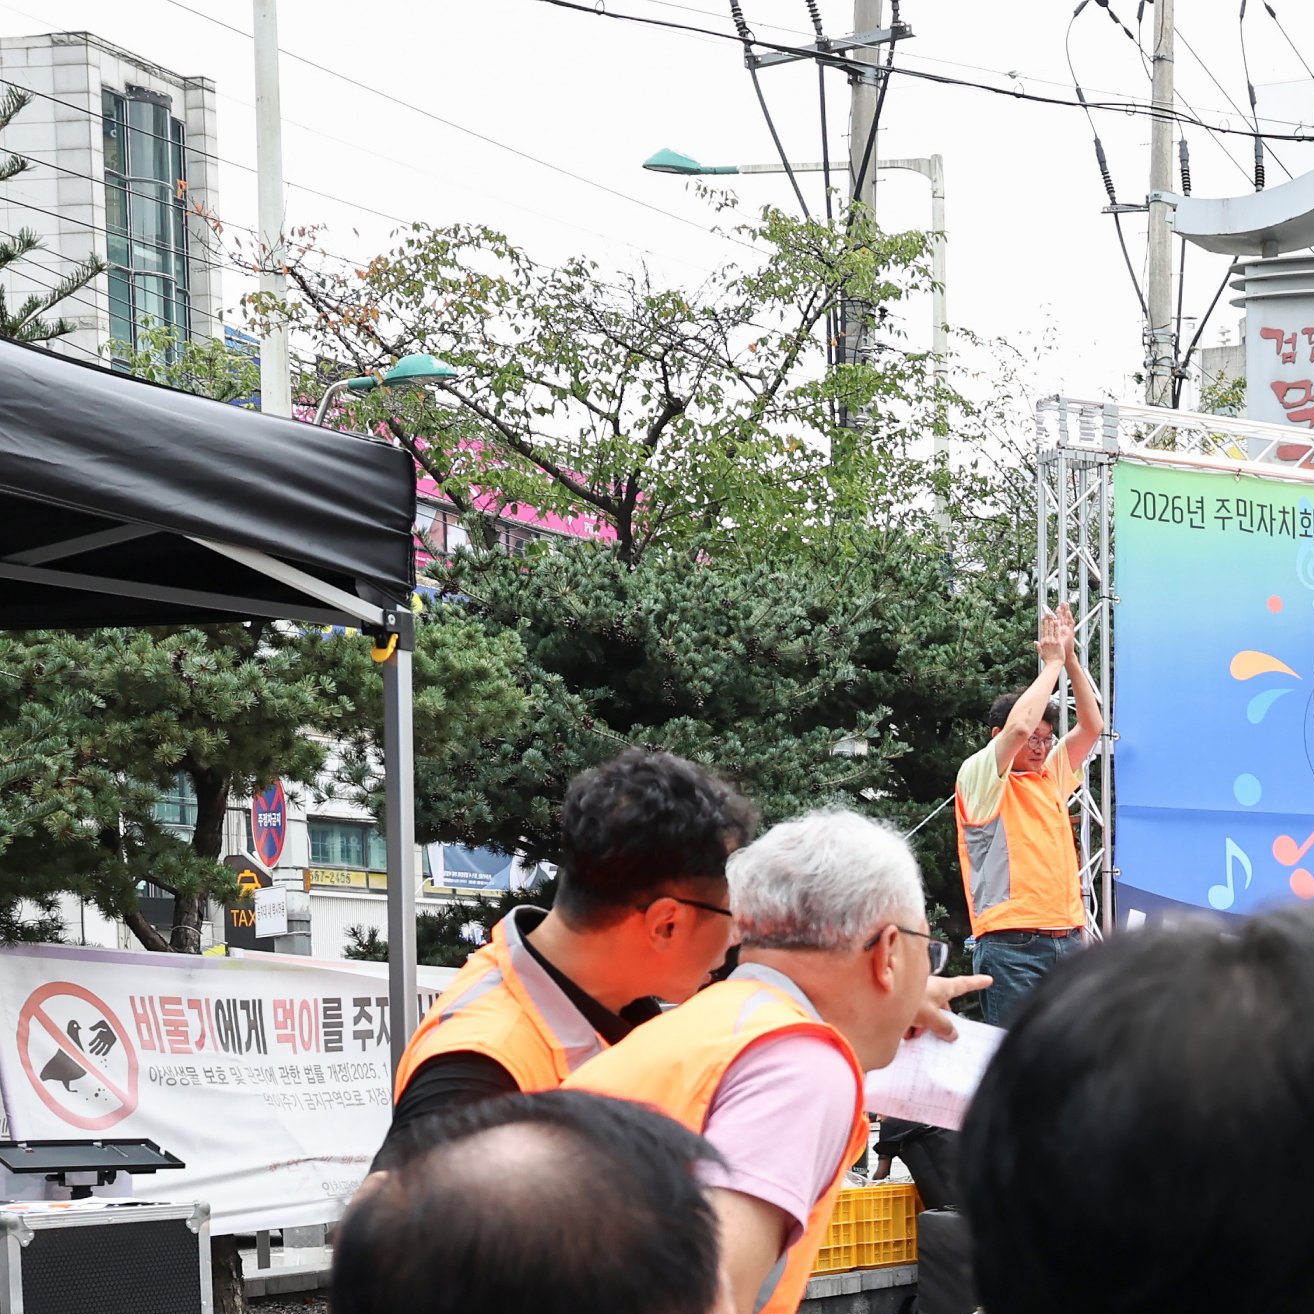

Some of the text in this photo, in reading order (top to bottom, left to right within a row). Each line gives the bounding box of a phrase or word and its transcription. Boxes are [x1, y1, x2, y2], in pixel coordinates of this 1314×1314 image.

[1129, 489, 1207, 531] 2026년
[129, 994, 345, 1056] 비둘기에게 먹이를
[203, 1064, 230, 1085] 보호
[279, 1065, 302, 1085] 관한
[305, 1063, 327, 1084] 법률
